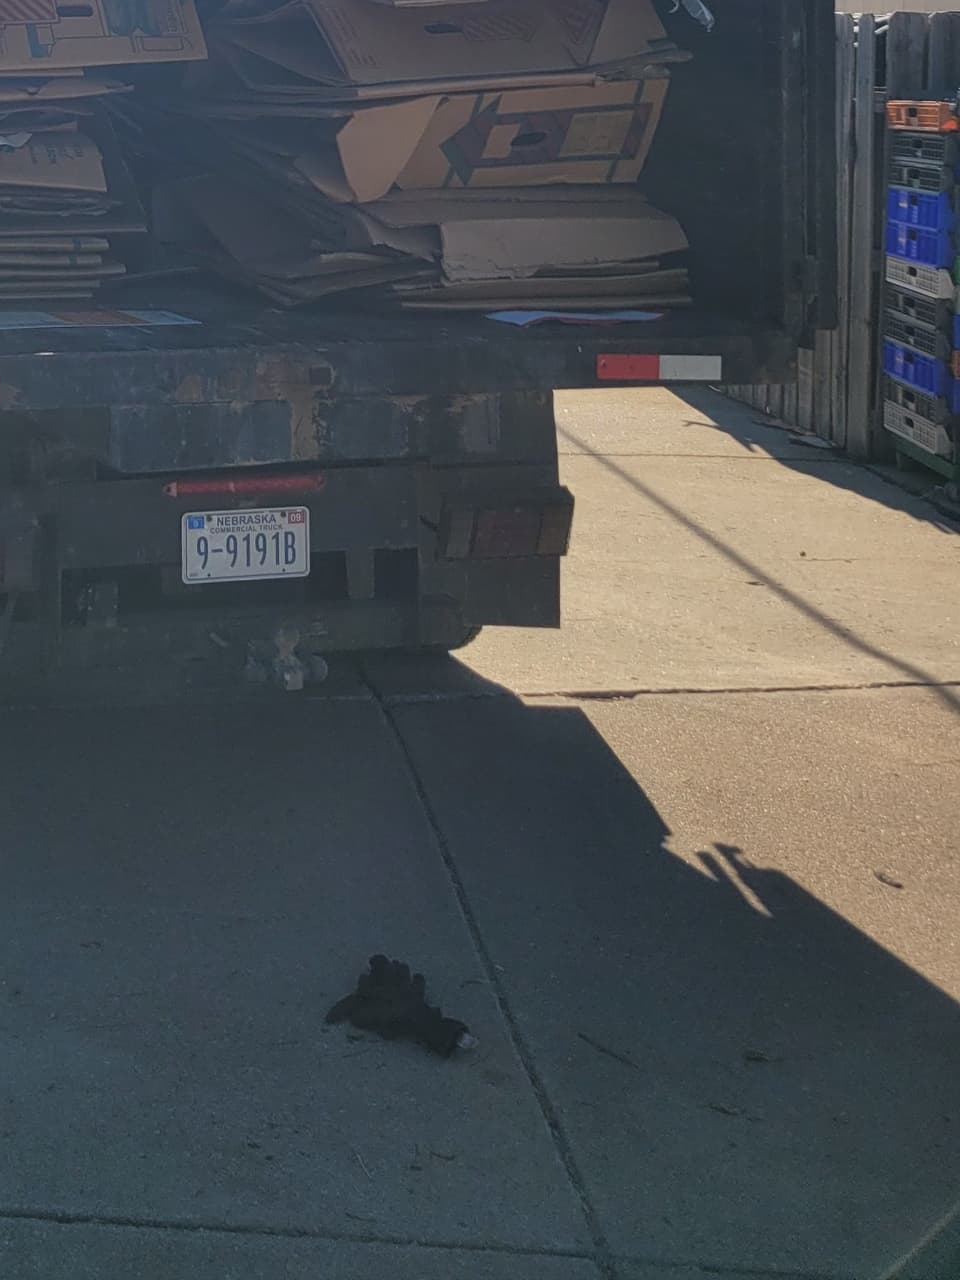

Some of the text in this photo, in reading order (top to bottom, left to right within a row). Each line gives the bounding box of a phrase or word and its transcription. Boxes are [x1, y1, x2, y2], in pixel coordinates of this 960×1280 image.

[216, 514, 277, 526] NEBRASKA
[290, 513, 301, 522] 09
[209, 523, 283, 535] COMMERCIAL TRUCK
[196, 531, 296, 570] 9-9191B
